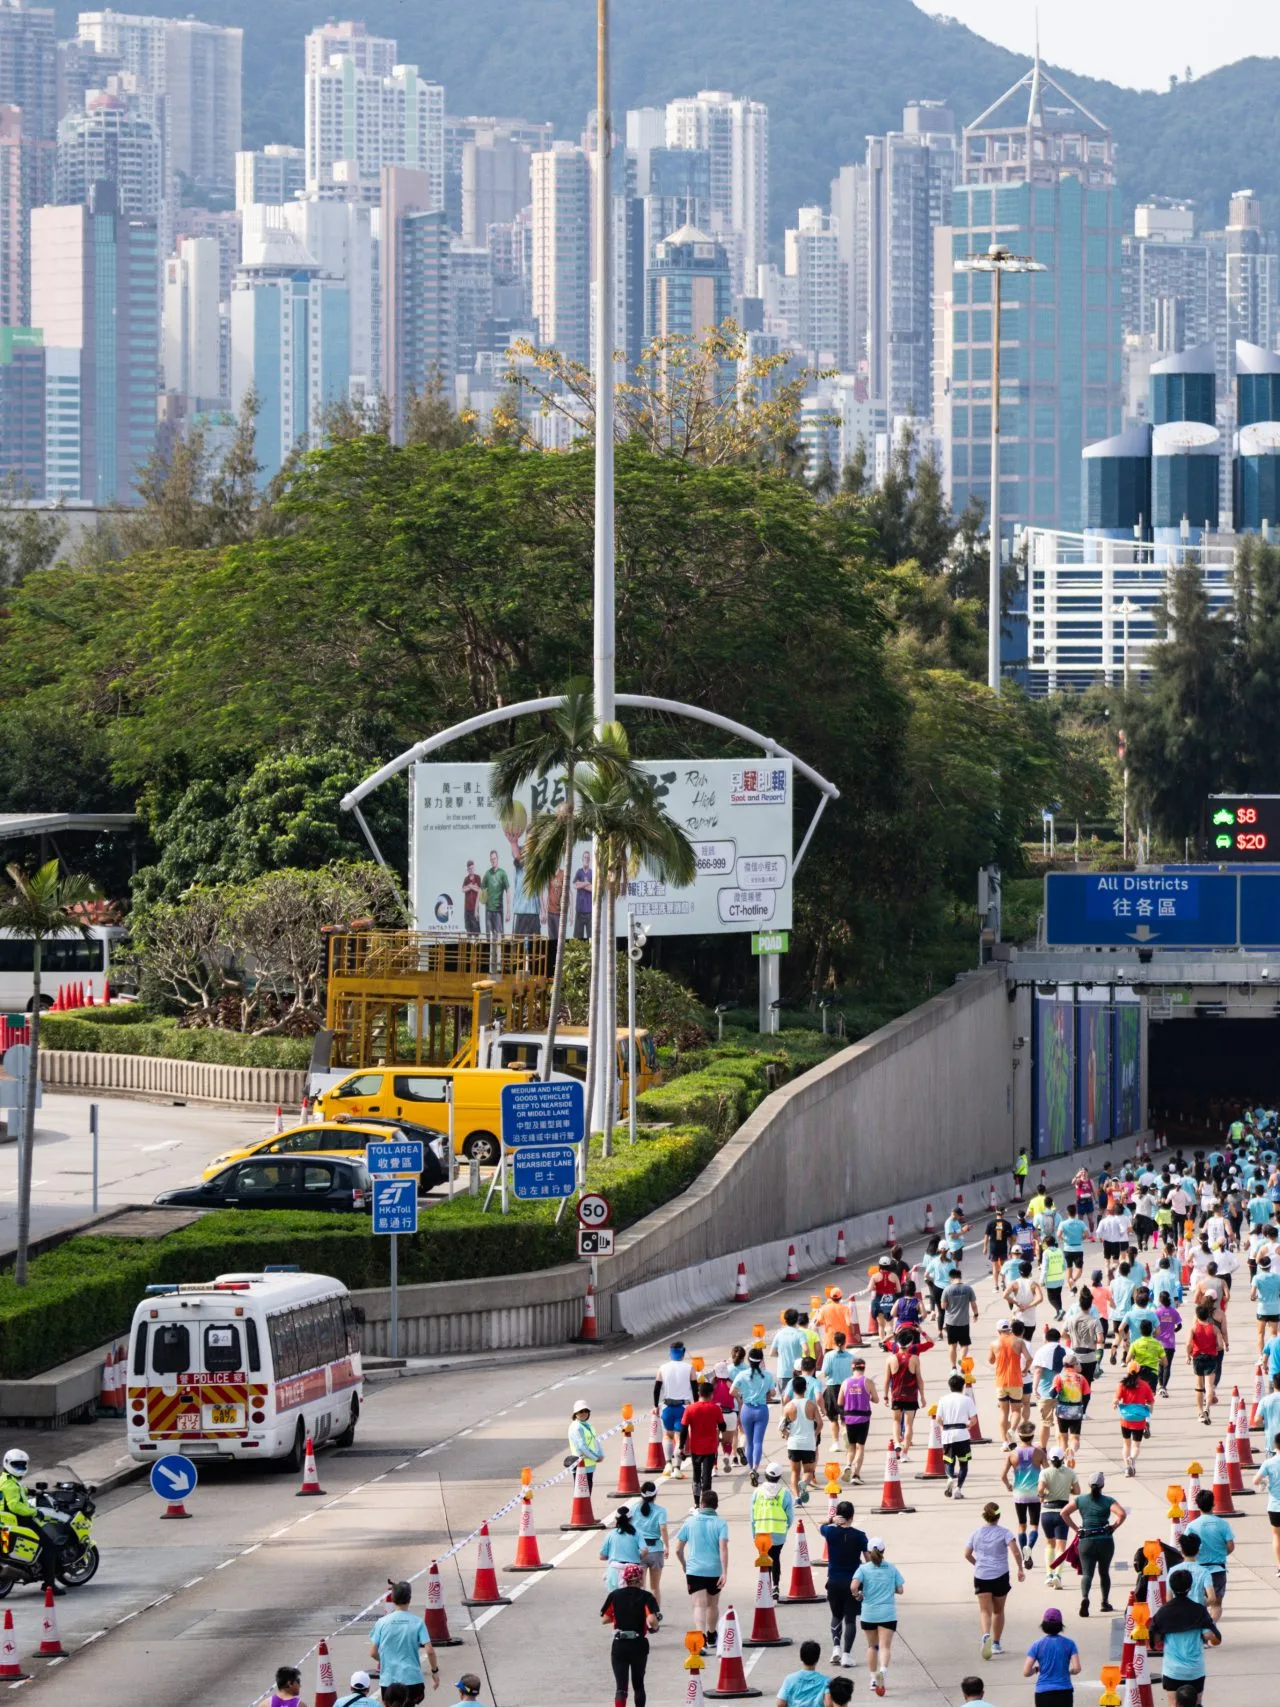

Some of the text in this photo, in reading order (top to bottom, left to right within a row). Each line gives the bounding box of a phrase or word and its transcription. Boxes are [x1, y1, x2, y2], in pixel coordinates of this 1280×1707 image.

[747, 793, 760, 801] and
[1236, 808, 1257, 825] $8
[1236, 833, 1266, 850] $20
[1097, 877, 1189, 891] All Districts
[729, 904, 768, 916] CT-hotline
[1112, 897, 1177, 917] 往各區
[552, 1084, 574, 1092] HEAVY
[539, 1093, 570, 1101] VEHICLES
[371, 1145, 419, 1155] TOLL AREA
[516, 1150, 572, 1160] BUSES KEEP TO
[516, 1159, 572, 1169] NEARSIDE LANE
[534, 1171, 555, 1182] 巴士
[583, 1203, 605, 1218] 50
[378, 1217, 413, 1229] 易通行
[193, 1373, 229, 1384] POLICE
[213, 1415, 235, 1423] 9876
